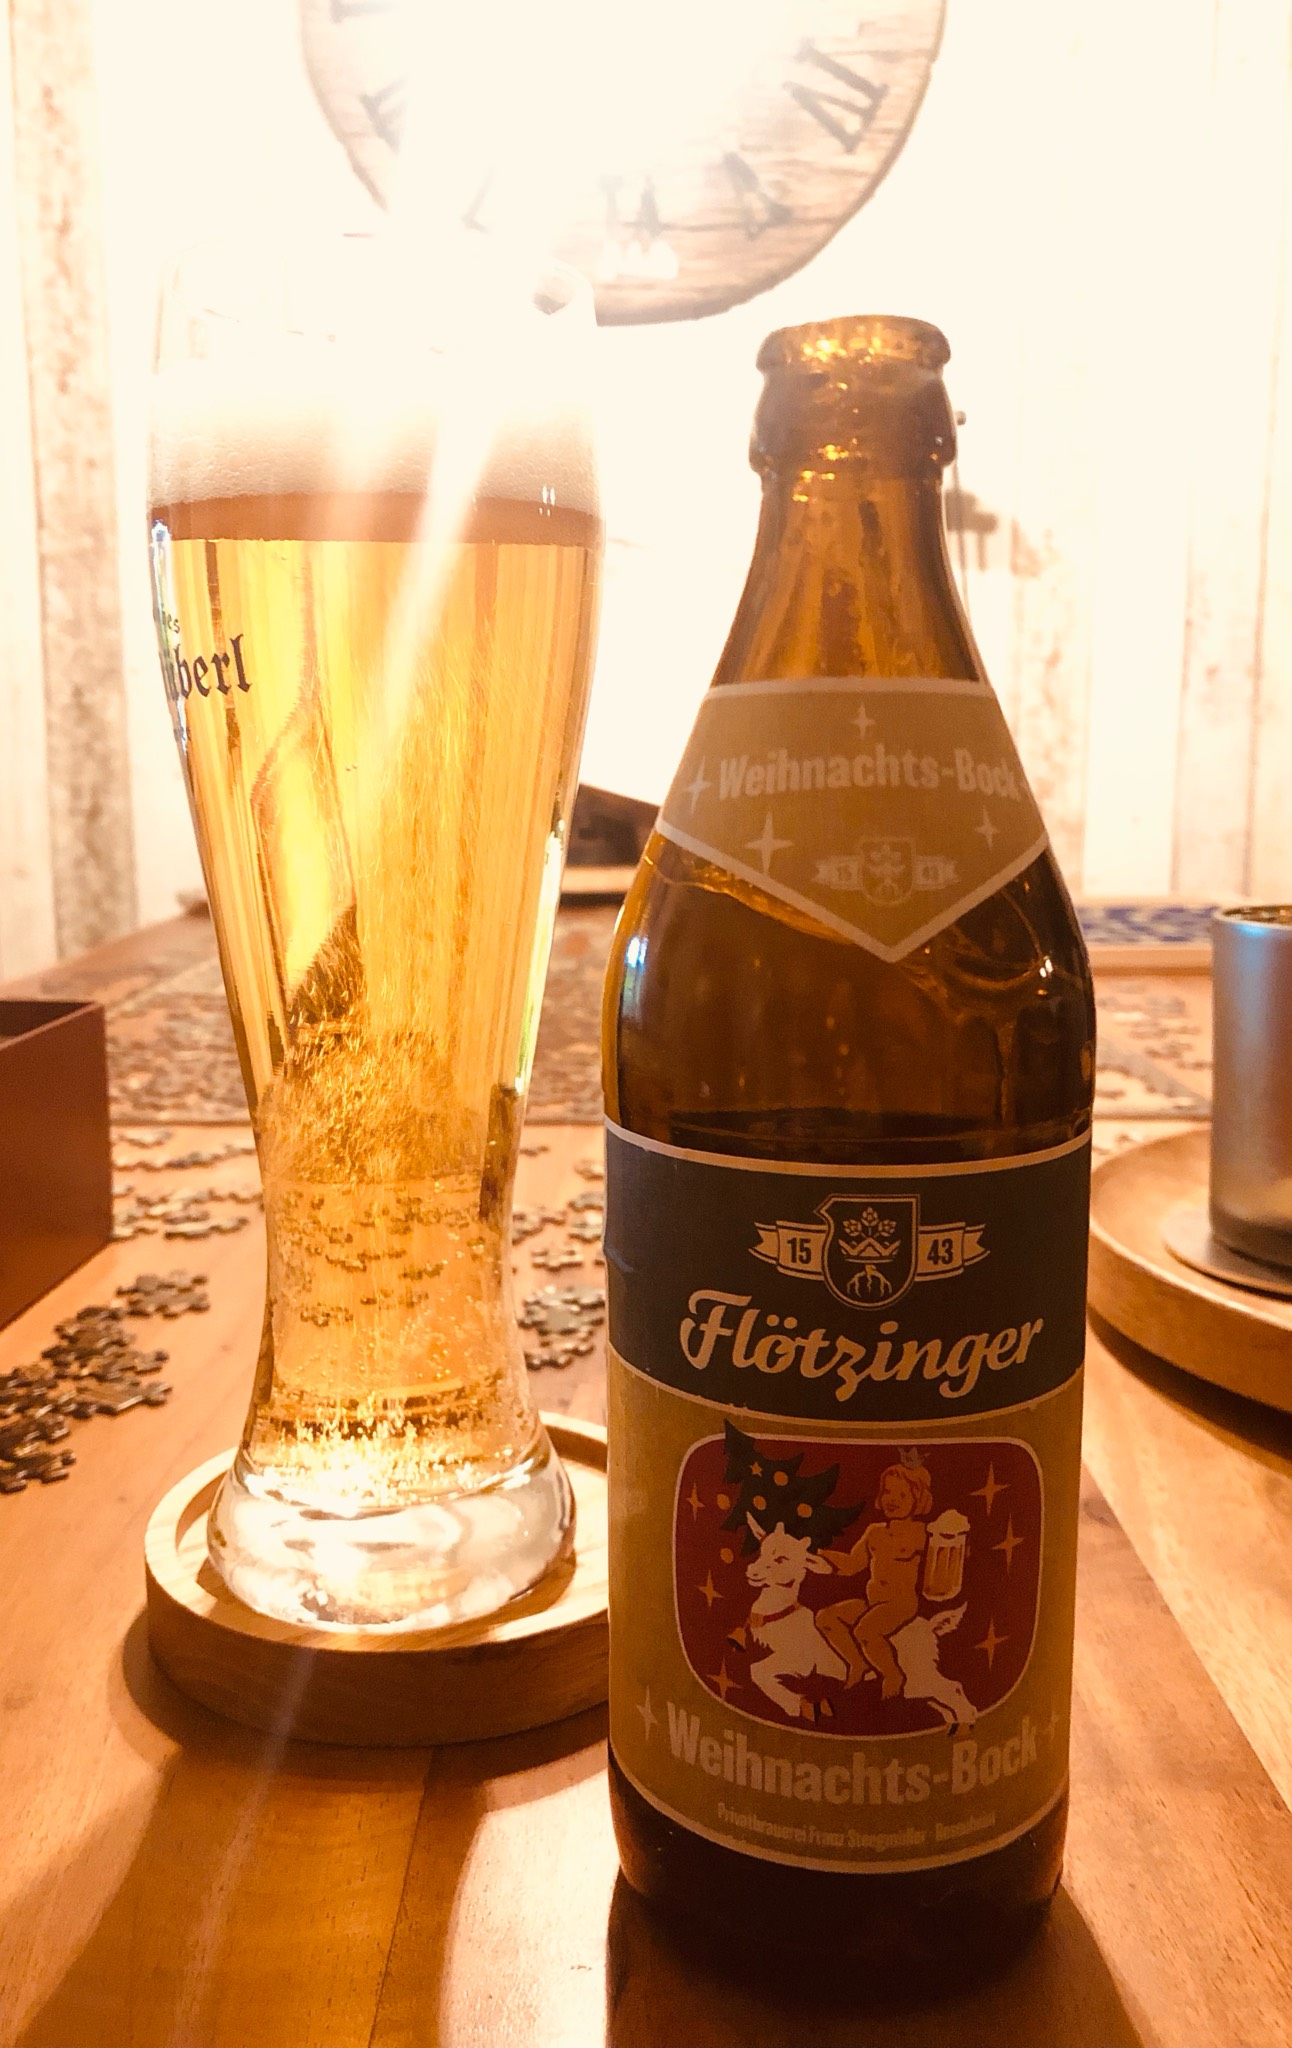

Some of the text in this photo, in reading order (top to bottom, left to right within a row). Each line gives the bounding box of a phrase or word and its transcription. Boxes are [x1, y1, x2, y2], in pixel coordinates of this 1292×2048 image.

[718, 742, 1021, 802] Weihnachts-Bock
[786, 1238, 954, 1265] 15 43
[679, 1289, 1044, 1402] Flötzinger
[667, 1700, 1038, 1806] Weihnachts-Bock
